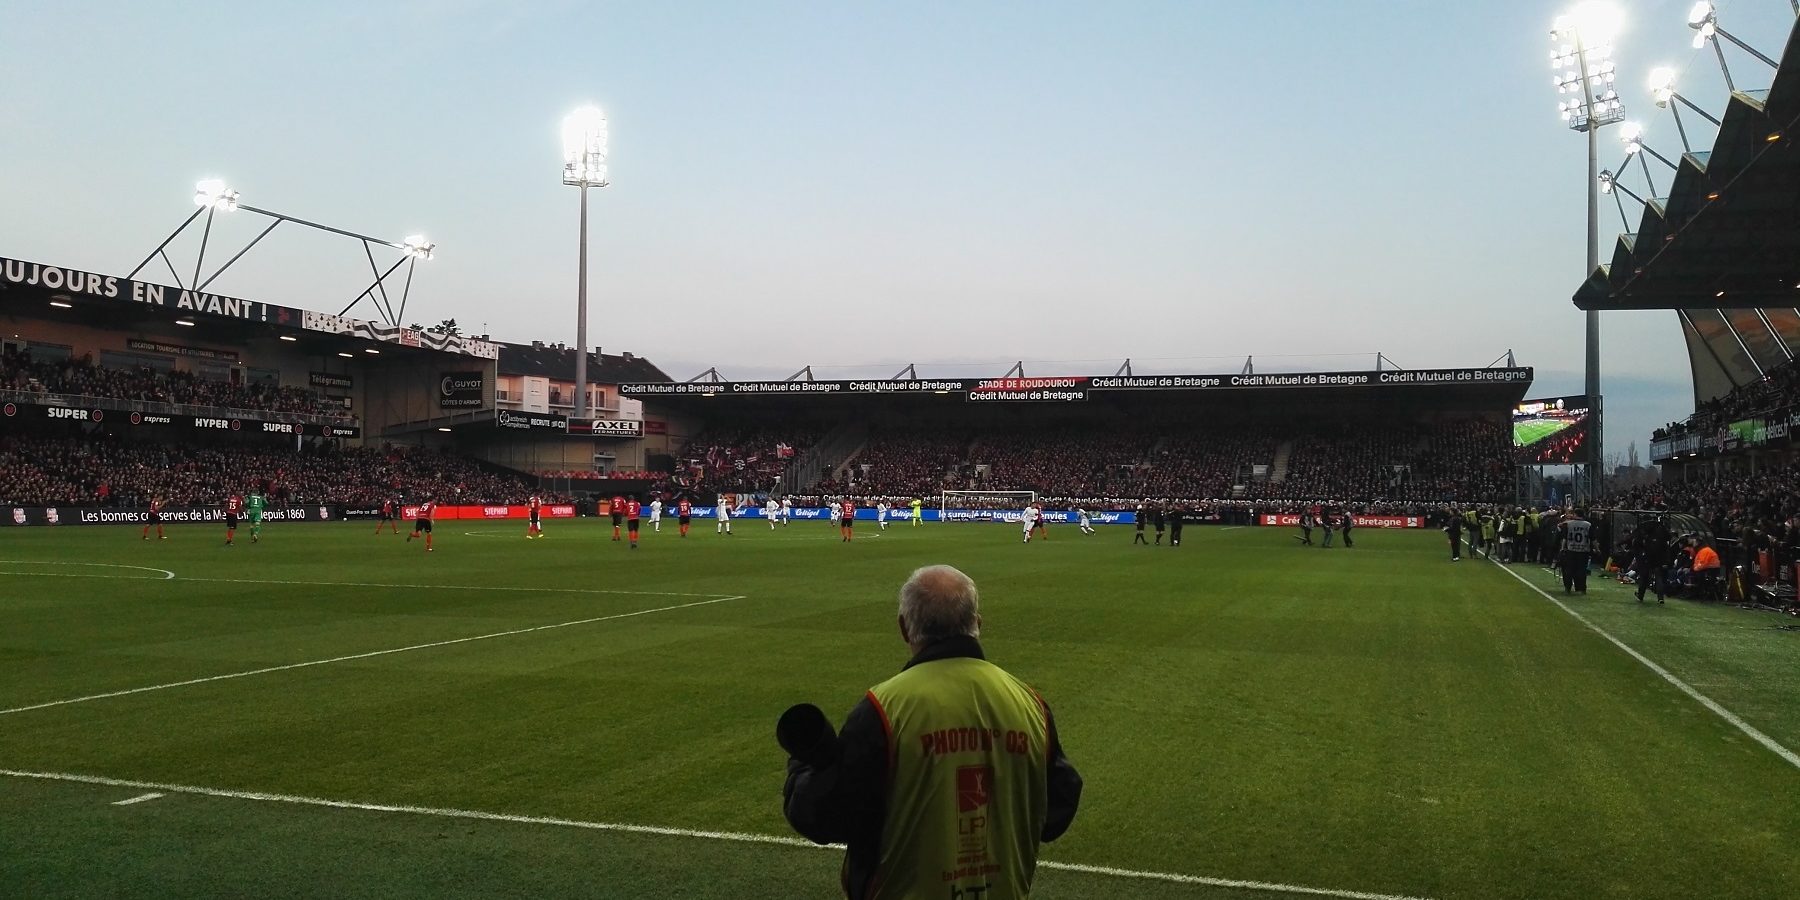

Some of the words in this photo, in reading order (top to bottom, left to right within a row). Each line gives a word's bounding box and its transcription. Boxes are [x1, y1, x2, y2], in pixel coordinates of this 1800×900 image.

[133, 281, 164, 305] EN
[177, 291, 253, 320] AVANT
[261, 303, 268, 322] !
[1231, 376, 1263, 386] Crédit
[1265, 375, 1300, 385] Mutuel
[1303, 375, 1316, 384] de
[1319, 374, 1368, 385] Bretagne
[1380, 372, 1414, 383] Crédit
[1417, 371, 1454, 382] Mutuel
[1457, 371, 1471, 380] de
[1474, 369, 1526, 382] Bretagne
[454, 380, 482, 388] GUYOT
[849, 382, 875, 391] Crédit
[877, 381, 908, 391] Mutuel
[909, 381, 920, 390] de
[922, 381, 962, 392] Bretagne
[978, 380, 1003, 389] STADE
[1006, 380, 1017, 388] DE
[1020, 379, 1075, 388] ROUDOUROU
[1092, 377, 1122, 388] Crédit
[1123, 377, 1157, 387] Mutuel
[1159, 377, 1171, 386] de
[1174, 376, 1220, 388] Bretagne
[621, 384, 647, 393] Crédit
[648, 384, 676, 393] Mutuel
[677, 384, 687, 393] de
[688, 384, 724, 394] Bretagne
[733, 383, 758, 393] Crédit
[760, 383, 788, 392] Mutuel
[790, 383, 801, 391] de
[802, 382, 840, 393] Bretagne
[970, 391, 996, 401] Crédit
[998, 391, 1028, 400] Mutuel
[1029, 391, 1040, 400] de
[1043, 391, 1083, 401] Bretagne
[48, 407, 88, 421] SUPER
[144, 415, 170, 426] express
[195, 417, 229, 430] HYPER
[263, 422, 292, 433] SUPER
[333, 429, 353, 437] express
[530, 418, 550, 427] RECRUTE
[595, 421, 636, 429] AXEL
[229, 502, 237, 510] 15
[484, 507, 508, 516] STEPHAN
[552, 506, 573, 515] STEPHAN
[81, 510, 99, 522] Les
[100, 510, 139, 521] bonnes
[140, 512, 188, 521] coserves
[190, 510, 202, 521] de
[203, 509, 211, 520] la
[286, 509, 305, 519] 1860
[891, 510, 914, 519] Celtige
[993, 511, 1021, 519] toutes
[1359, 517, 1402, 527] Bretagne
[921, 727, 978, 757] PHOTO
[981, 727, 1001, 755] N°
[1006, 730, 1028, 755] 03
